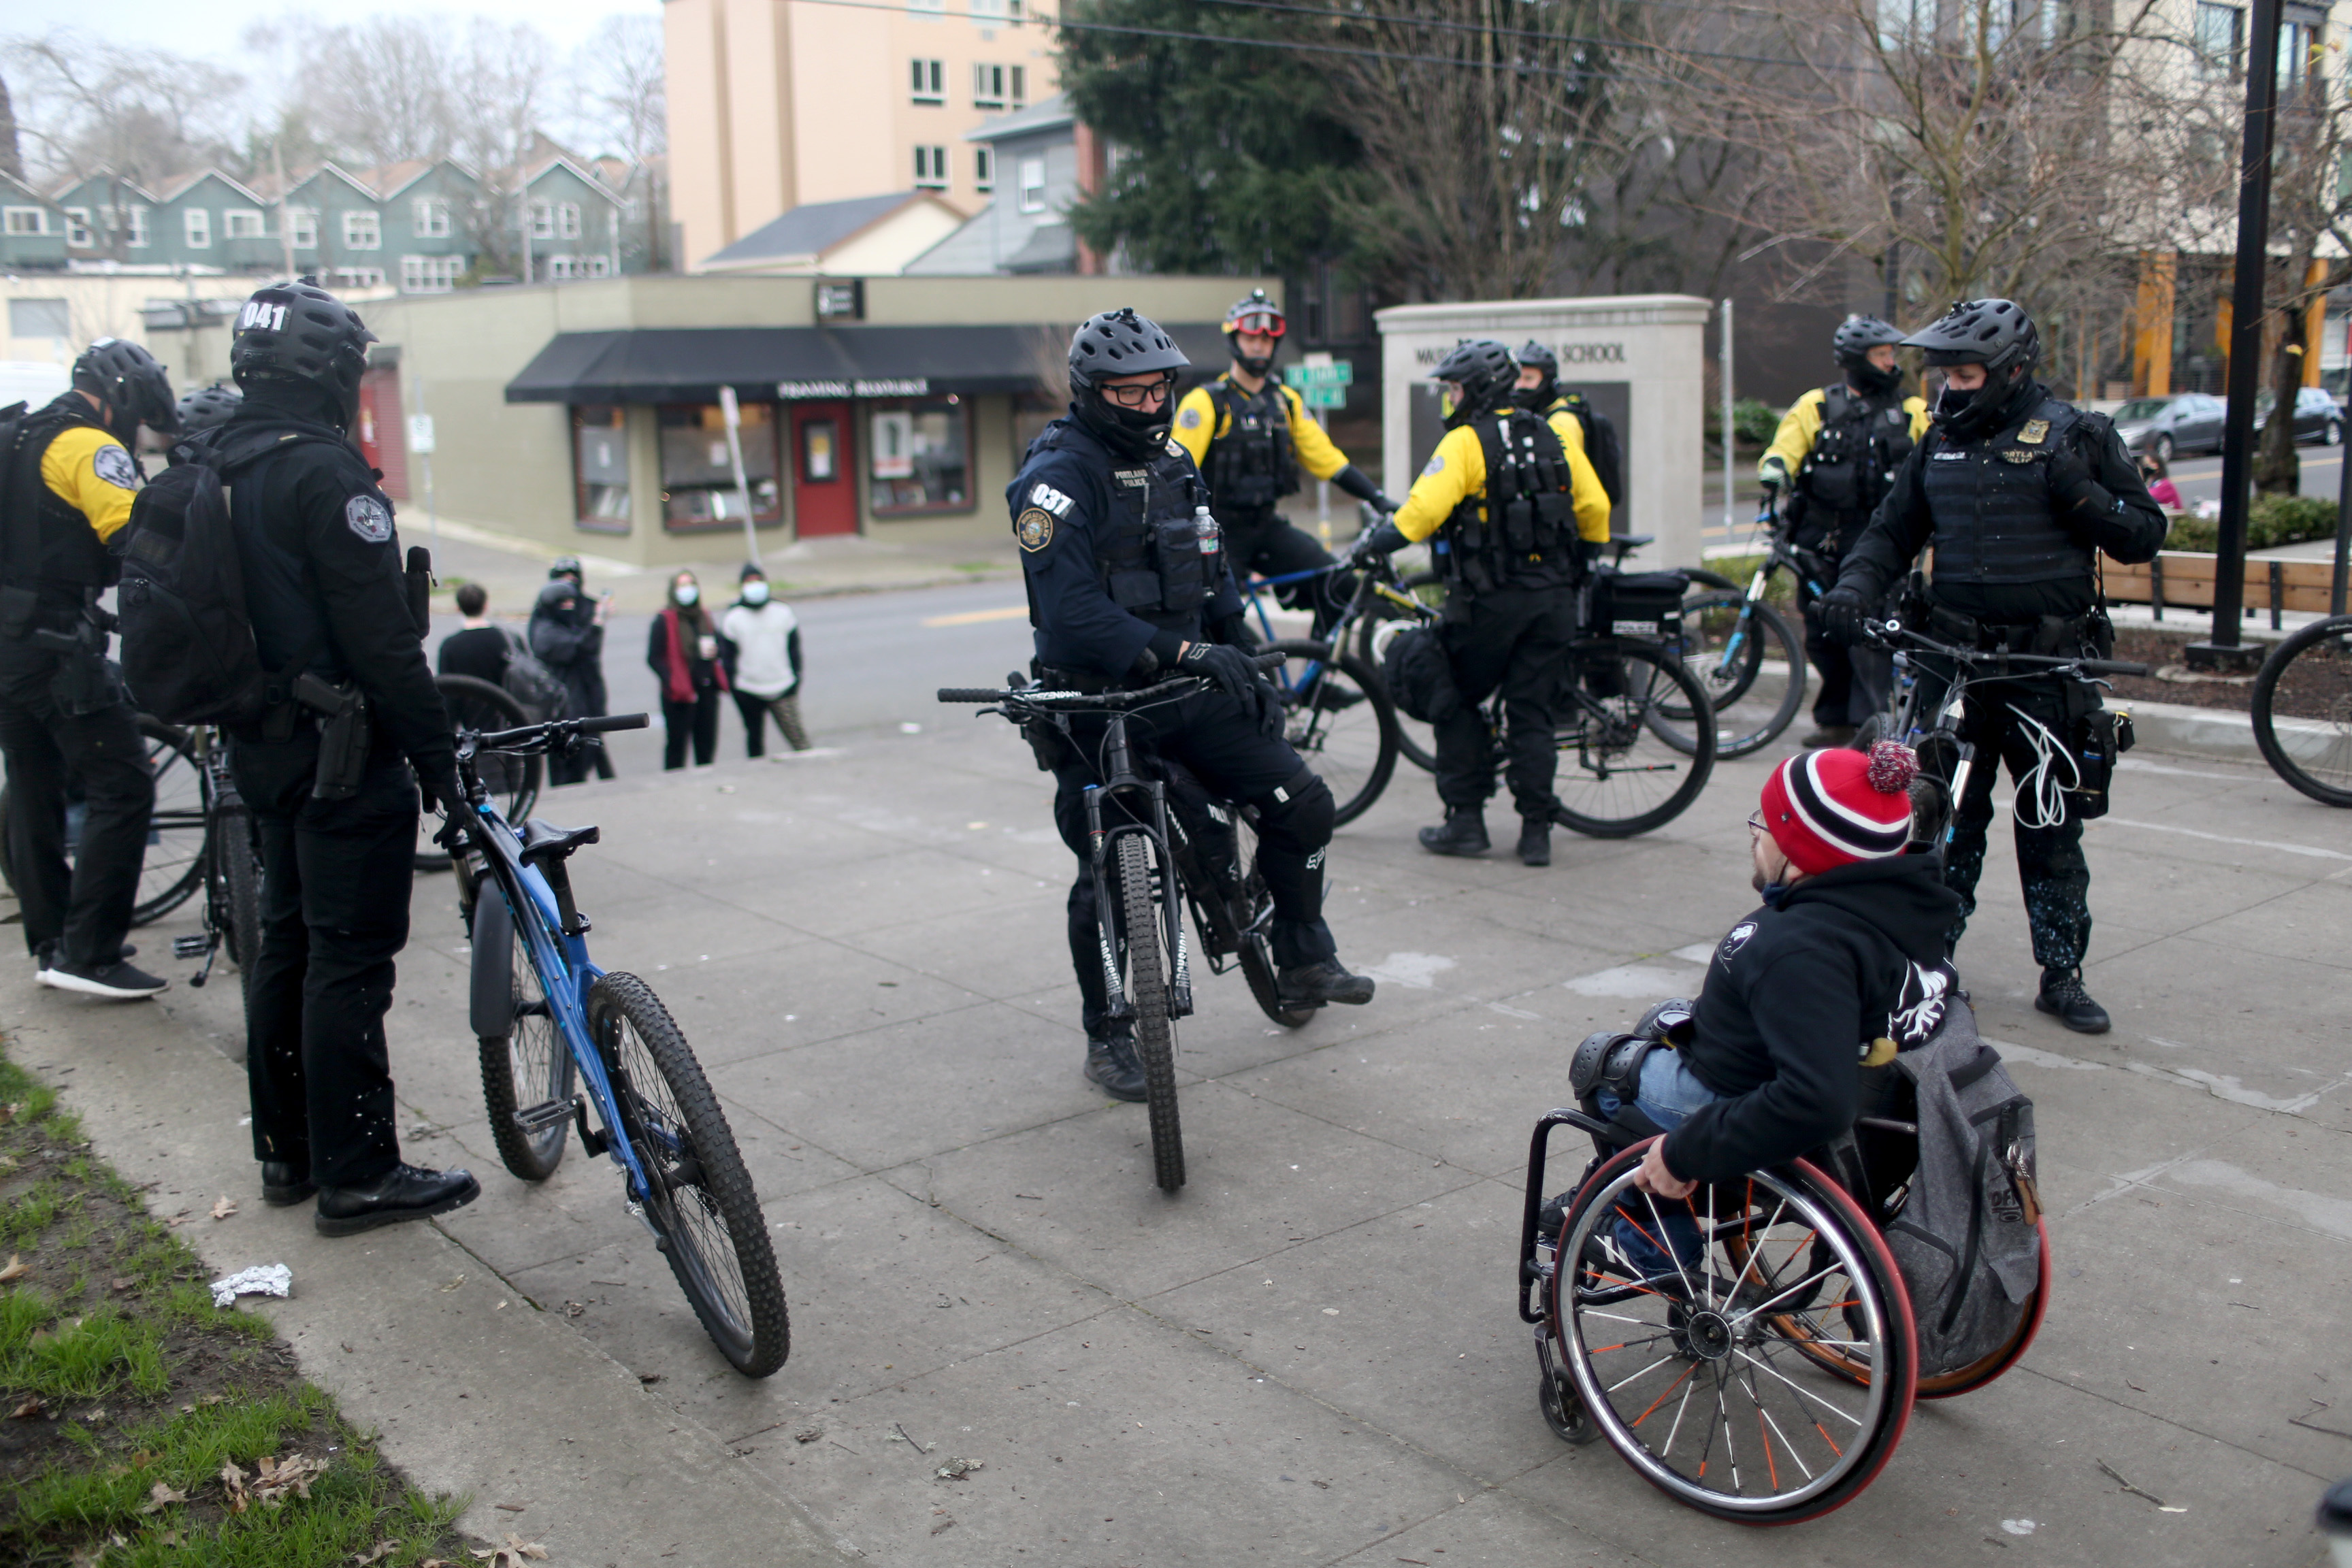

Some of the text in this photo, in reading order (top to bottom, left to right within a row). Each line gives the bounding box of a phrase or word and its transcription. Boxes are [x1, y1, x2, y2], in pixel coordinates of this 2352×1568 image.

[244, 302, 286, 331] 041
[1562, 343, 1627, 363] SCHOOL
[778, 377, 929, 399] FRAMING RESOURCE
[1114, 469, 1148, 479] PORTLAND
[1122, 477, 1147, 487] POLICE
[1032, 483, 1072, 515] 037
